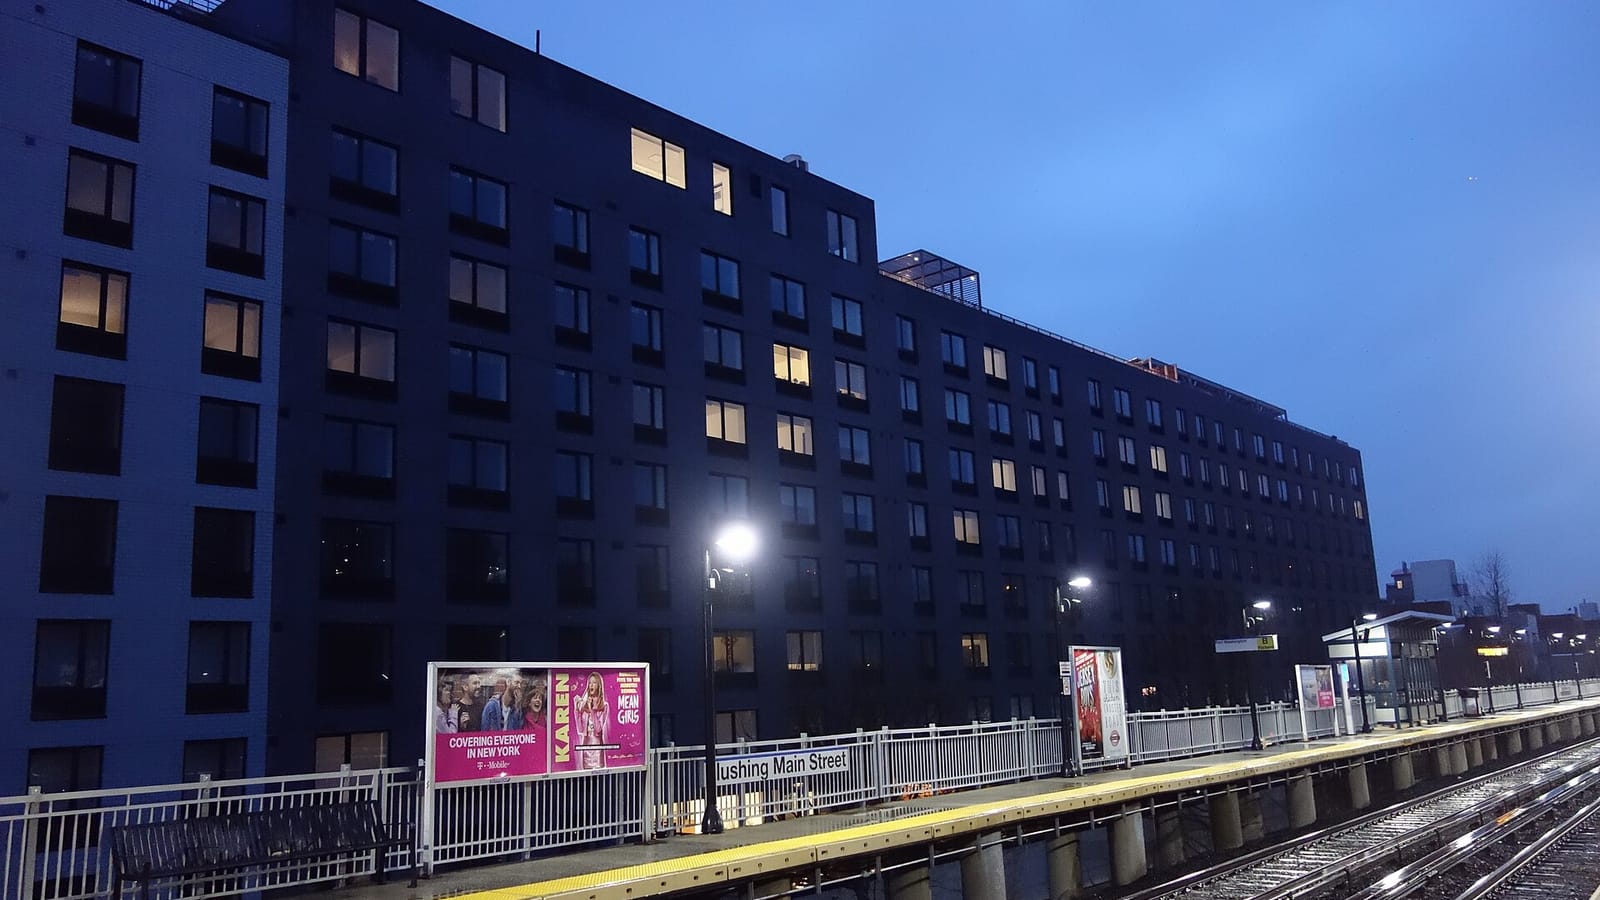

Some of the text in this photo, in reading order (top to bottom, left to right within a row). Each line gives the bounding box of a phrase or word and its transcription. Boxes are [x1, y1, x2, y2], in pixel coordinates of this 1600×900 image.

[617, 694, 639, 710] MEAN
[555, 673, 570, 763] KAREN
[617, 709, 640, 725] GIRLS
[449, 733, 536, 749] COVERING EVERYONE
[467, 745, 520, 759] IN NEW YORK
[716, 751, 847, 780] lushing Main Street
